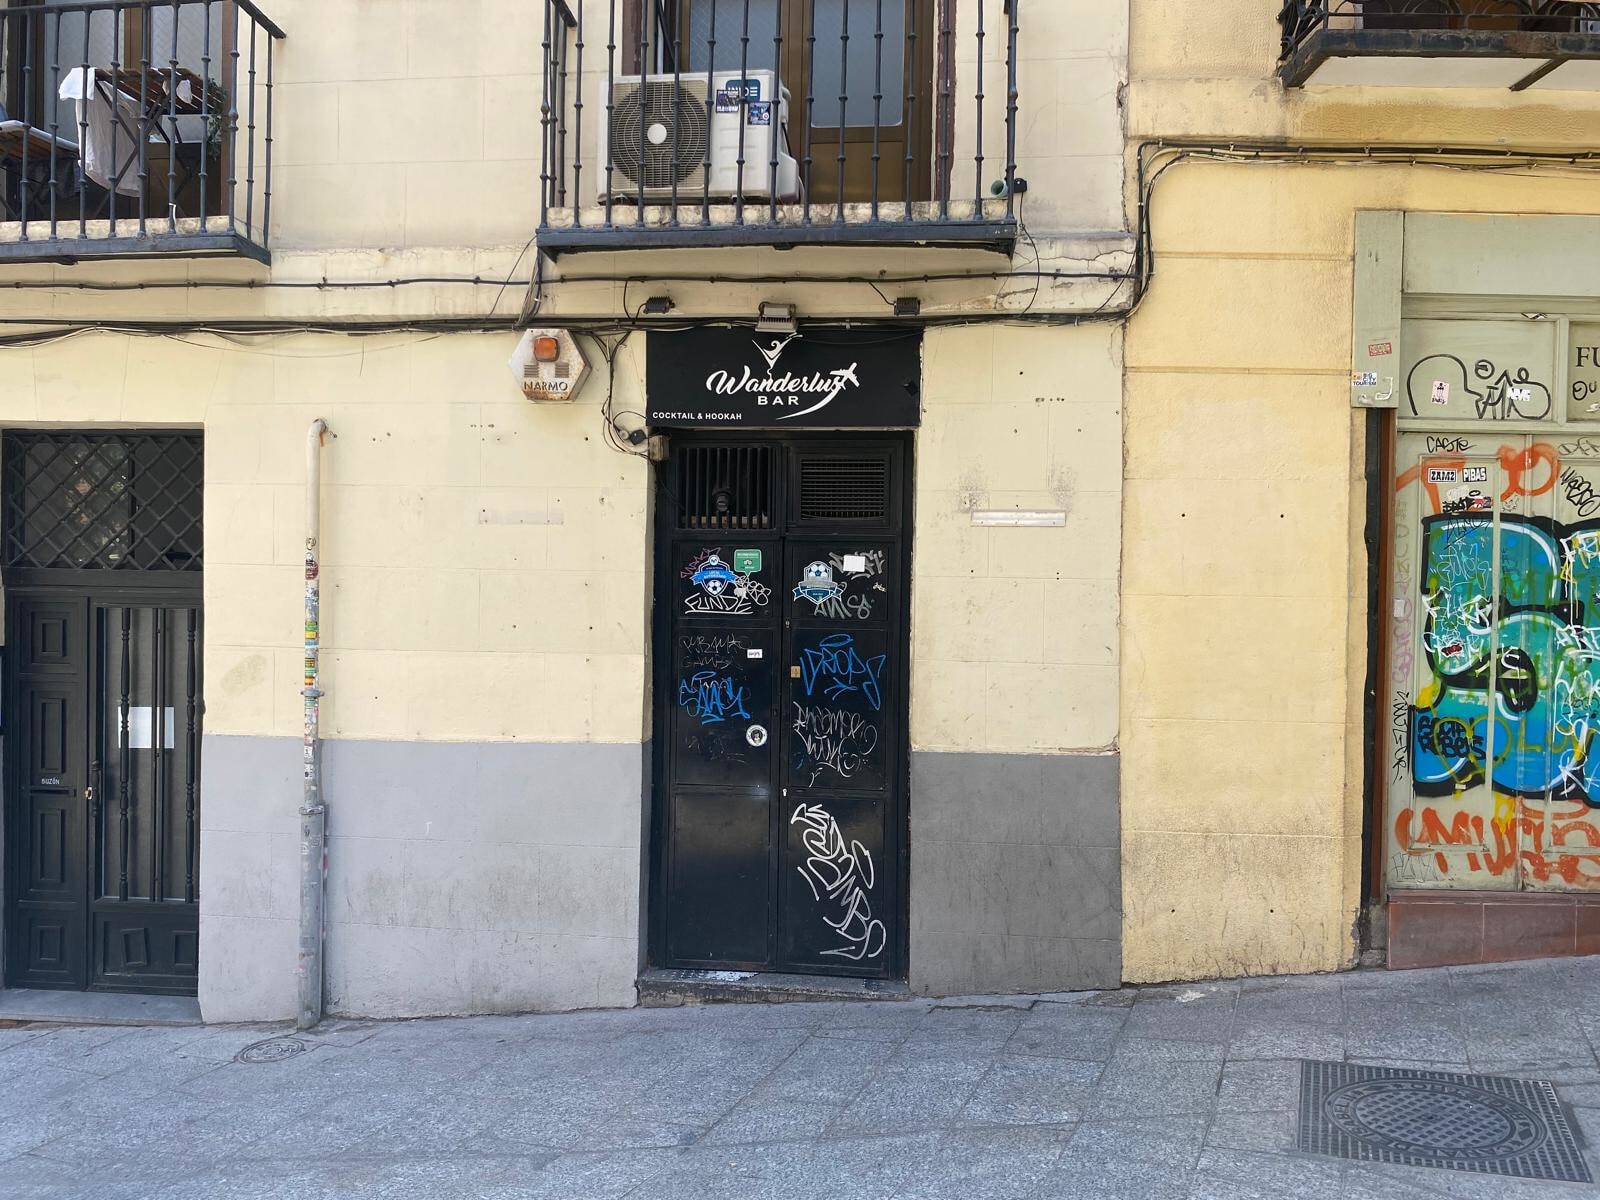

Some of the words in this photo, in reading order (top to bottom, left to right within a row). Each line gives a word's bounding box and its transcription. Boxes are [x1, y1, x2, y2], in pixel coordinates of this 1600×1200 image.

[524, 381, 568, 391] NARMO
[757, 395, 799, 406] BAR
[652, 411, 696, 420] COCKTAIL
[697, 412, 703, 420] &
[705, 412, 742, 420] HOOKAH
[1463, 467, 1487, 482] PIBAS
